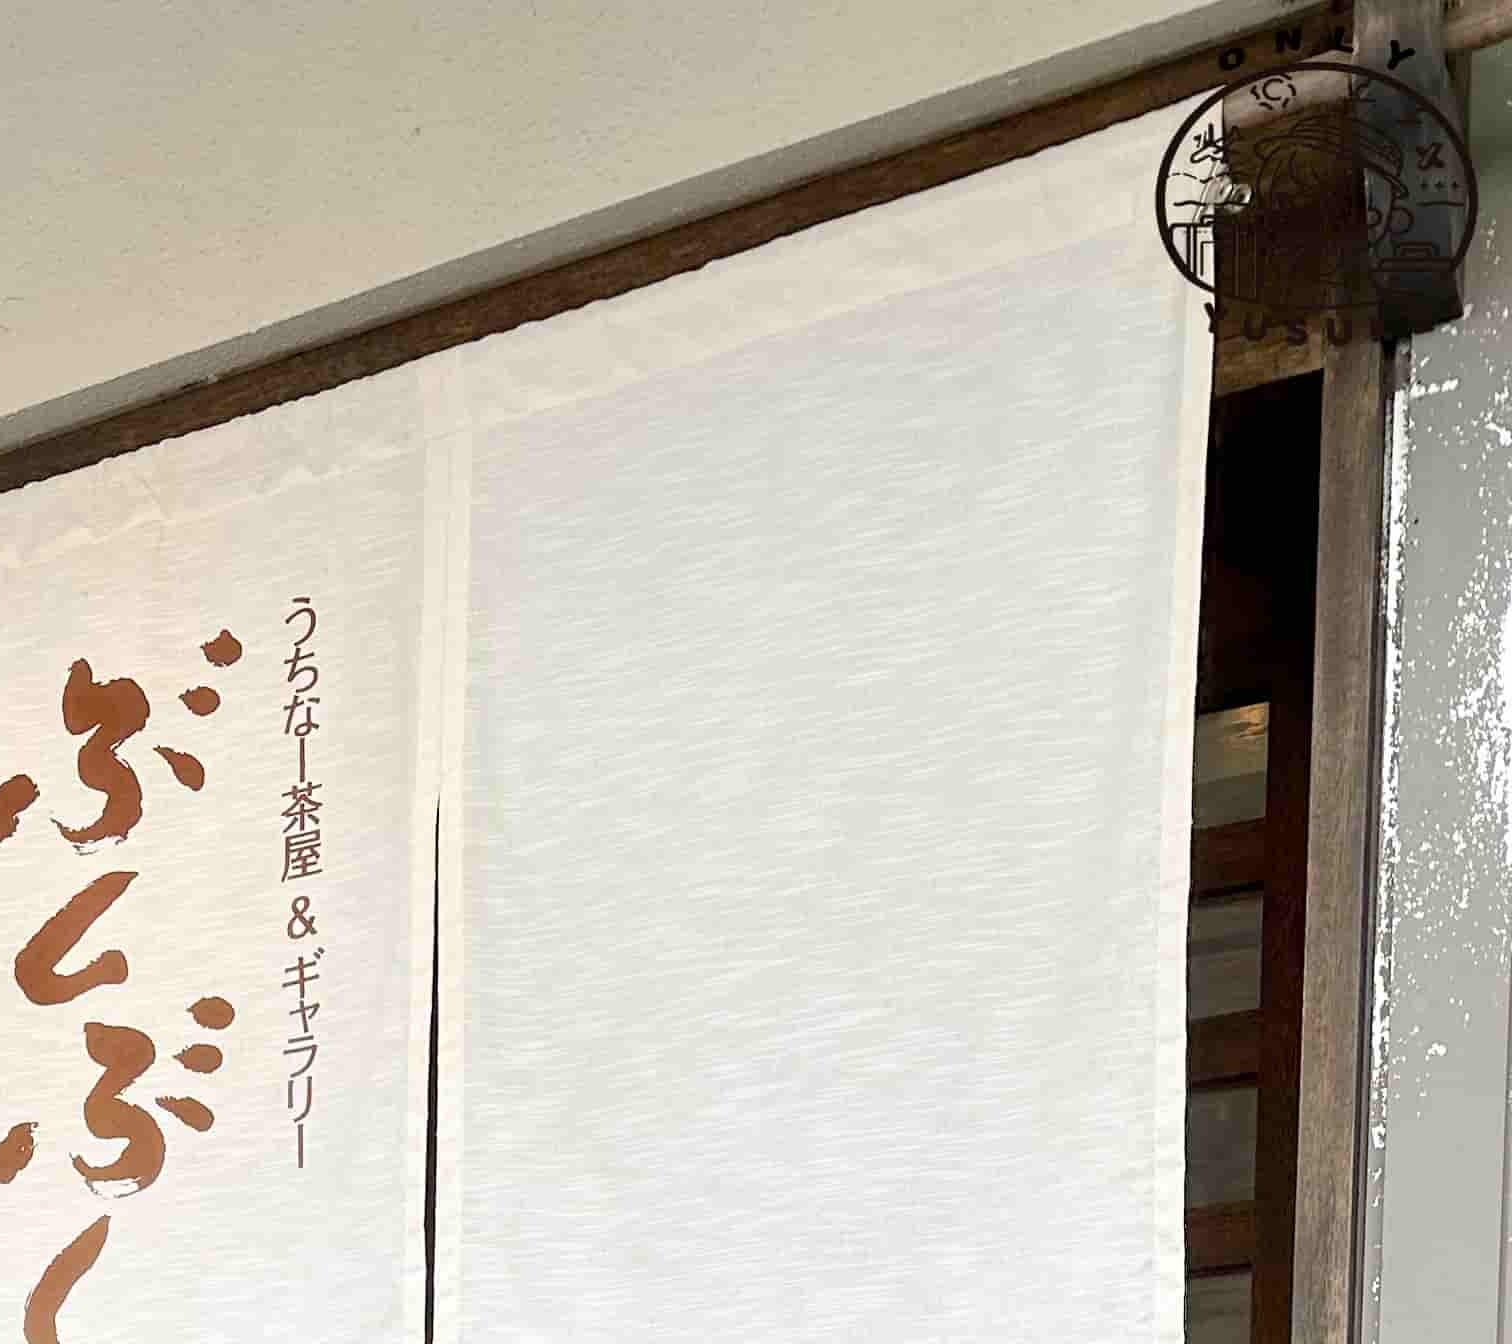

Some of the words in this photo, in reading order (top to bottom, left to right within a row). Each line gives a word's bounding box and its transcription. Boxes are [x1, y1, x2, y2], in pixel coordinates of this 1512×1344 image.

[281, 597, 323, 883] うちなー茶屋
[287, 896, 319, 939] &
[281, 947, 325, 1169] ギャラリー
